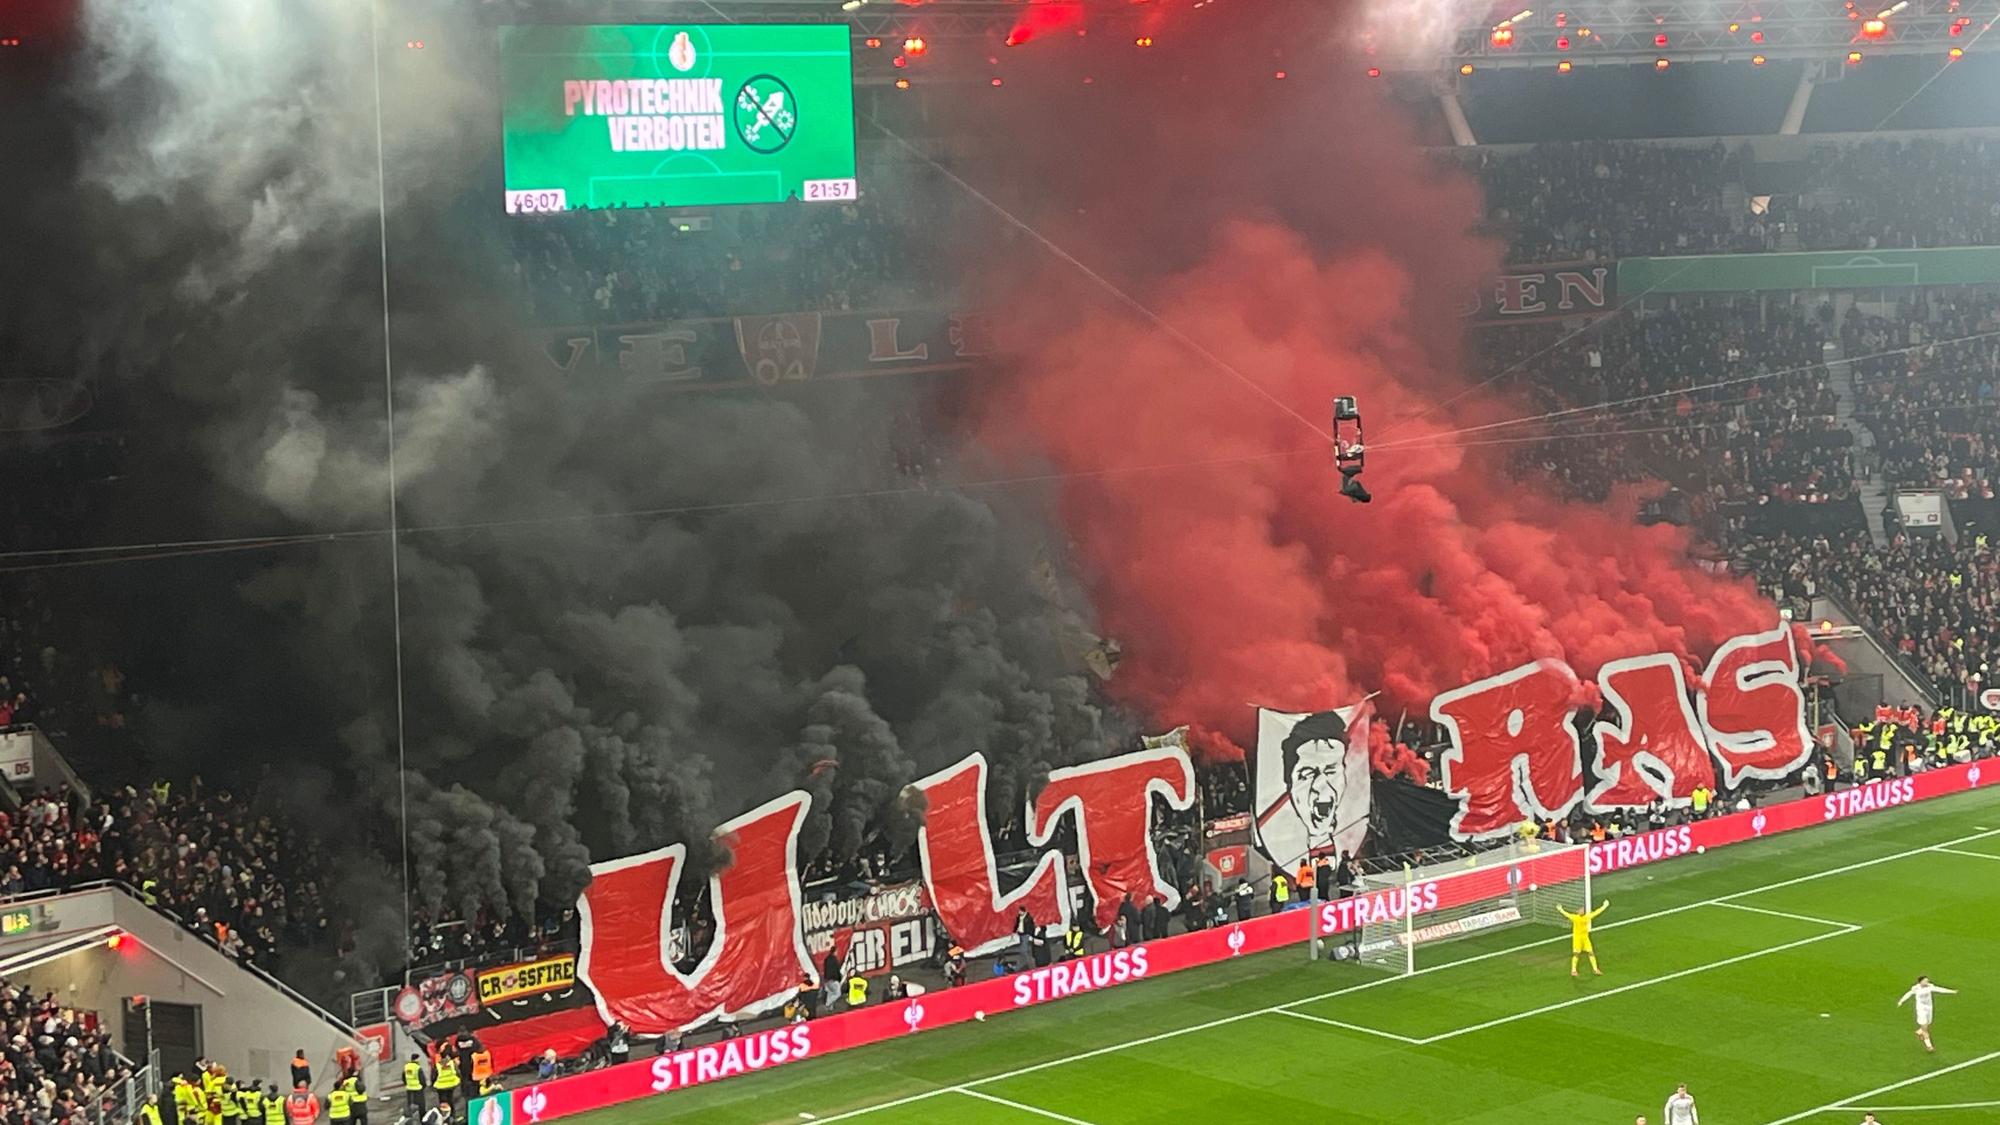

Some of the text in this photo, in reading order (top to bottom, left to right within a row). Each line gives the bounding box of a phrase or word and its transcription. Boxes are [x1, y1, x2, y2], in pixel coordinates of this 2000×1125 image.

[564, 78, 724, 116] PYROTECHNIK
[608, 114, 726, 152] VERBOTEN
[513, 193, 559, 210] 46:07
[809, 182, 851, 198] 21:57
[1824, 776, 1914, 820] STRAUSS
[1589, 825, 1692, 873] STRAUSS
[1321, 882, 1439, 934] STRAUSS
[480, 959, 575, 998] CROSSFIRE
[1014, 947, 1149, 1006] STRAUSS
[651, 1025, 812, 1092] STRAUSS
